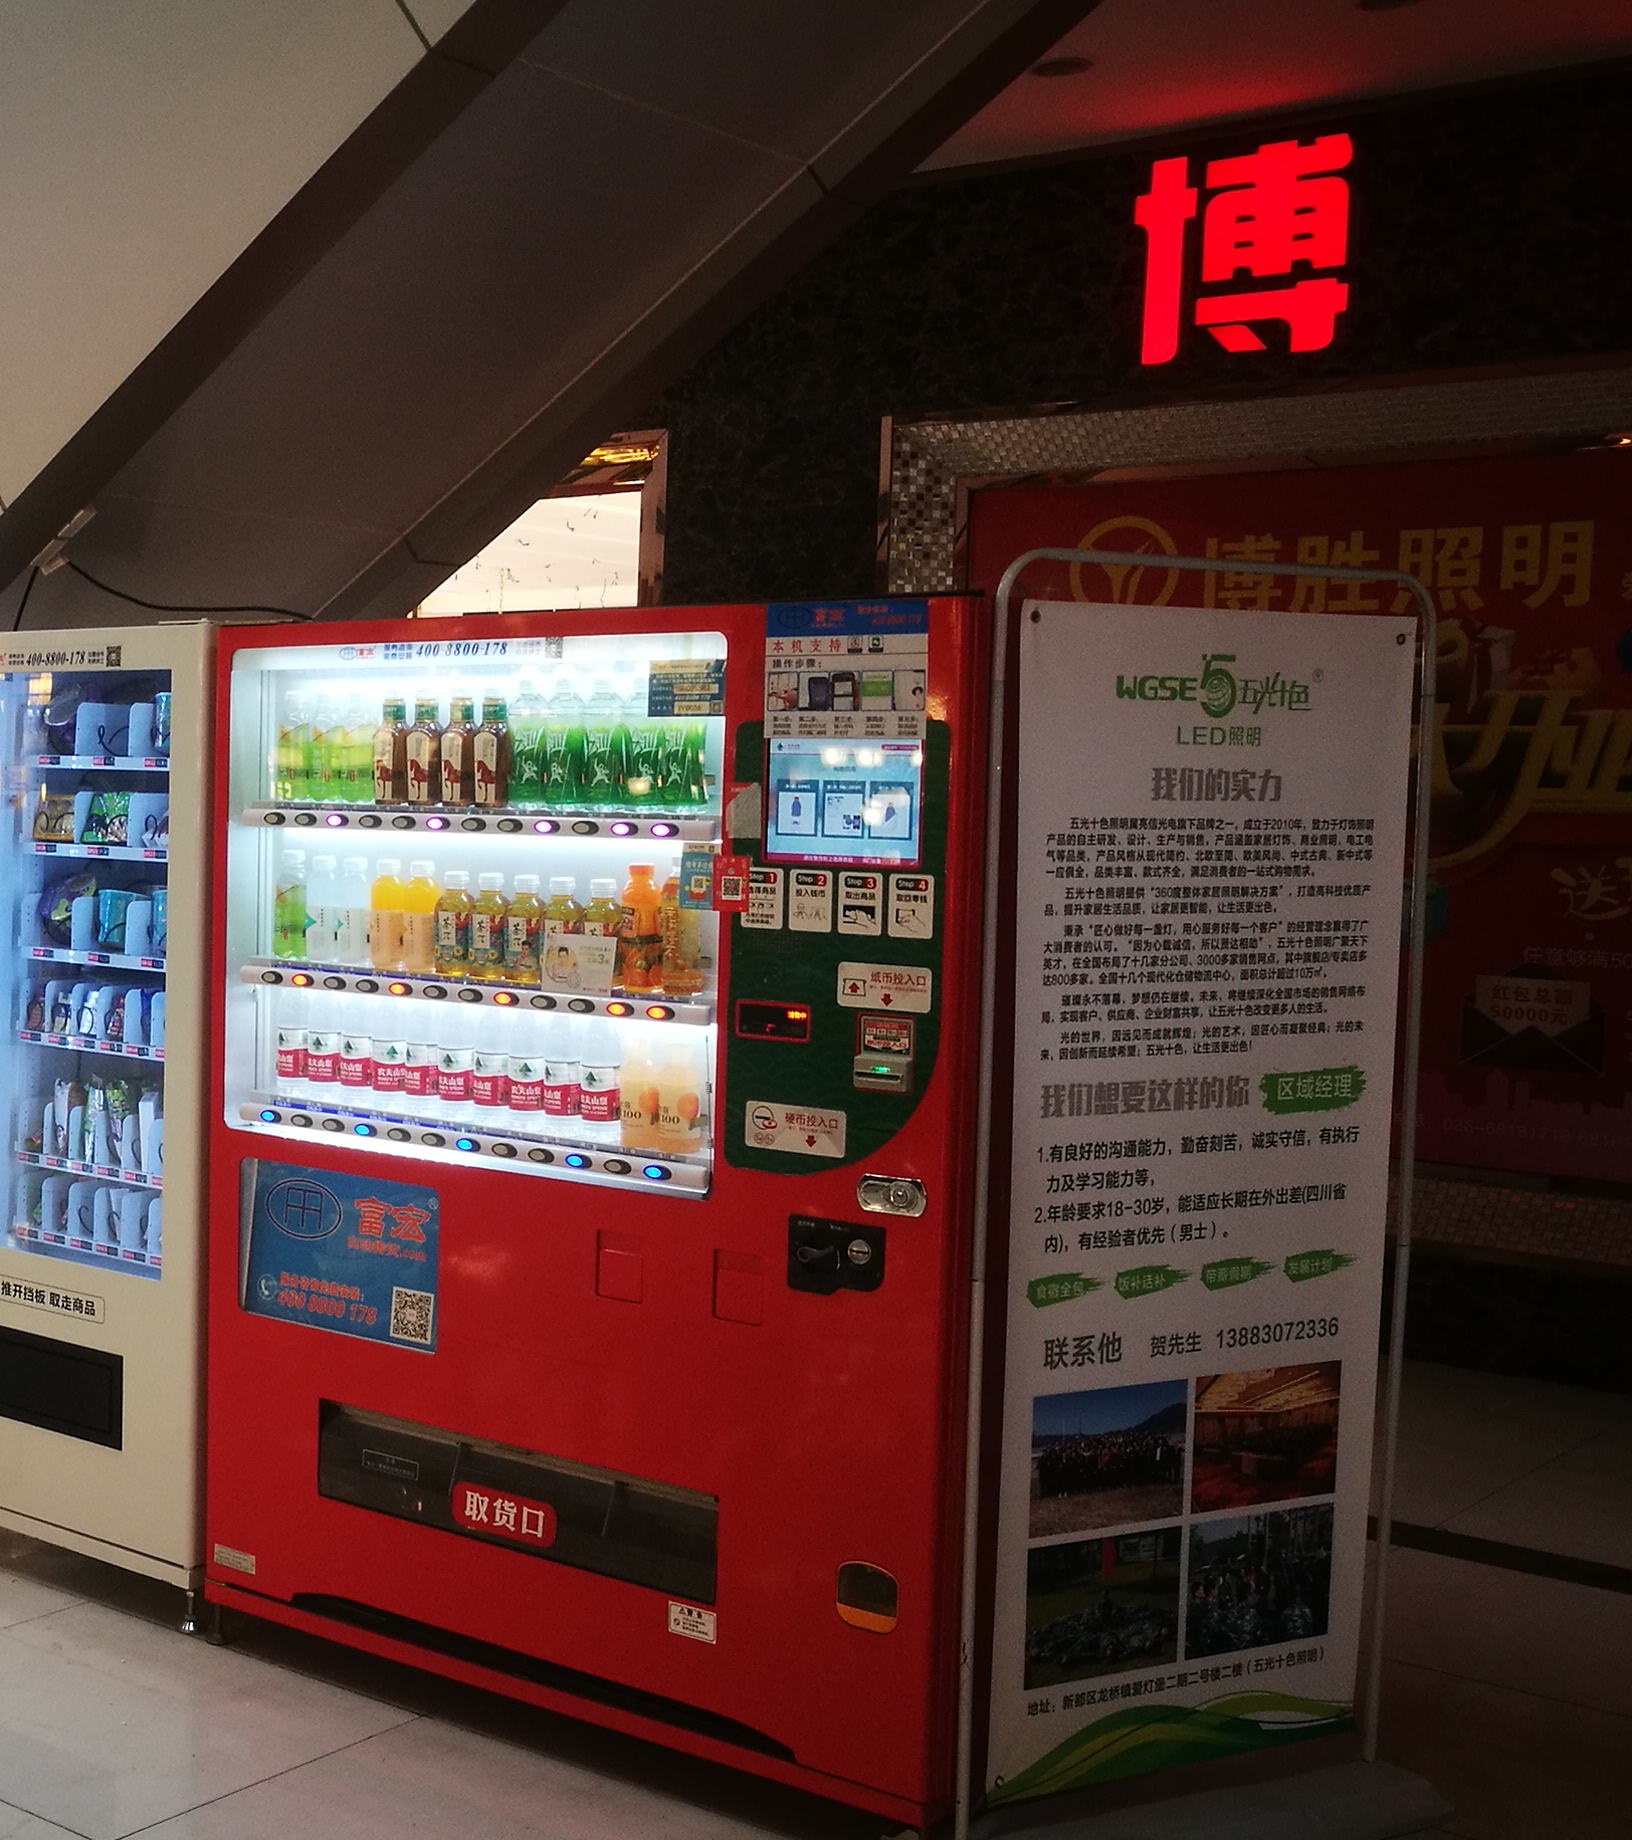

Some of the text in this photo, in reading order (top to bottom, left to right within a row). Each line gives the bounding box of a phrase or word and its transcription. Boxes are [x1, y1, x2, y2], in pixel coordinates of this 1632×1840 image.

[1134, 133, 1353, 365] 博
[26, 651, 87, 667] 400-8800-178
[416, 641, 509, 657] 400-8800-178
[773, 637, 842, 653] 本机支持
[1176, 726, 1262, 747] LED照明
[1151, 766, 1283, 802] 我们的实力
[870, 971, 927, 987] 纸币投入口
[1039, 1074, 1251, 1119] 我们想要这样的你
[1277, 1073, 1356, 1101] 区域经理
[784, 1111, 839, 1130] 硬币投入口
[353, 1196, 432, 1243] 富宏
[0, 1280, 97, 1317] 推开挡板 取走商品
[276, 1290, 378, 1325] 400 8800 178
[1043, 1316, 1340, 1371] 联系他 贺先生 13883072336
[463, 1489, 545, 1540] 取货口
